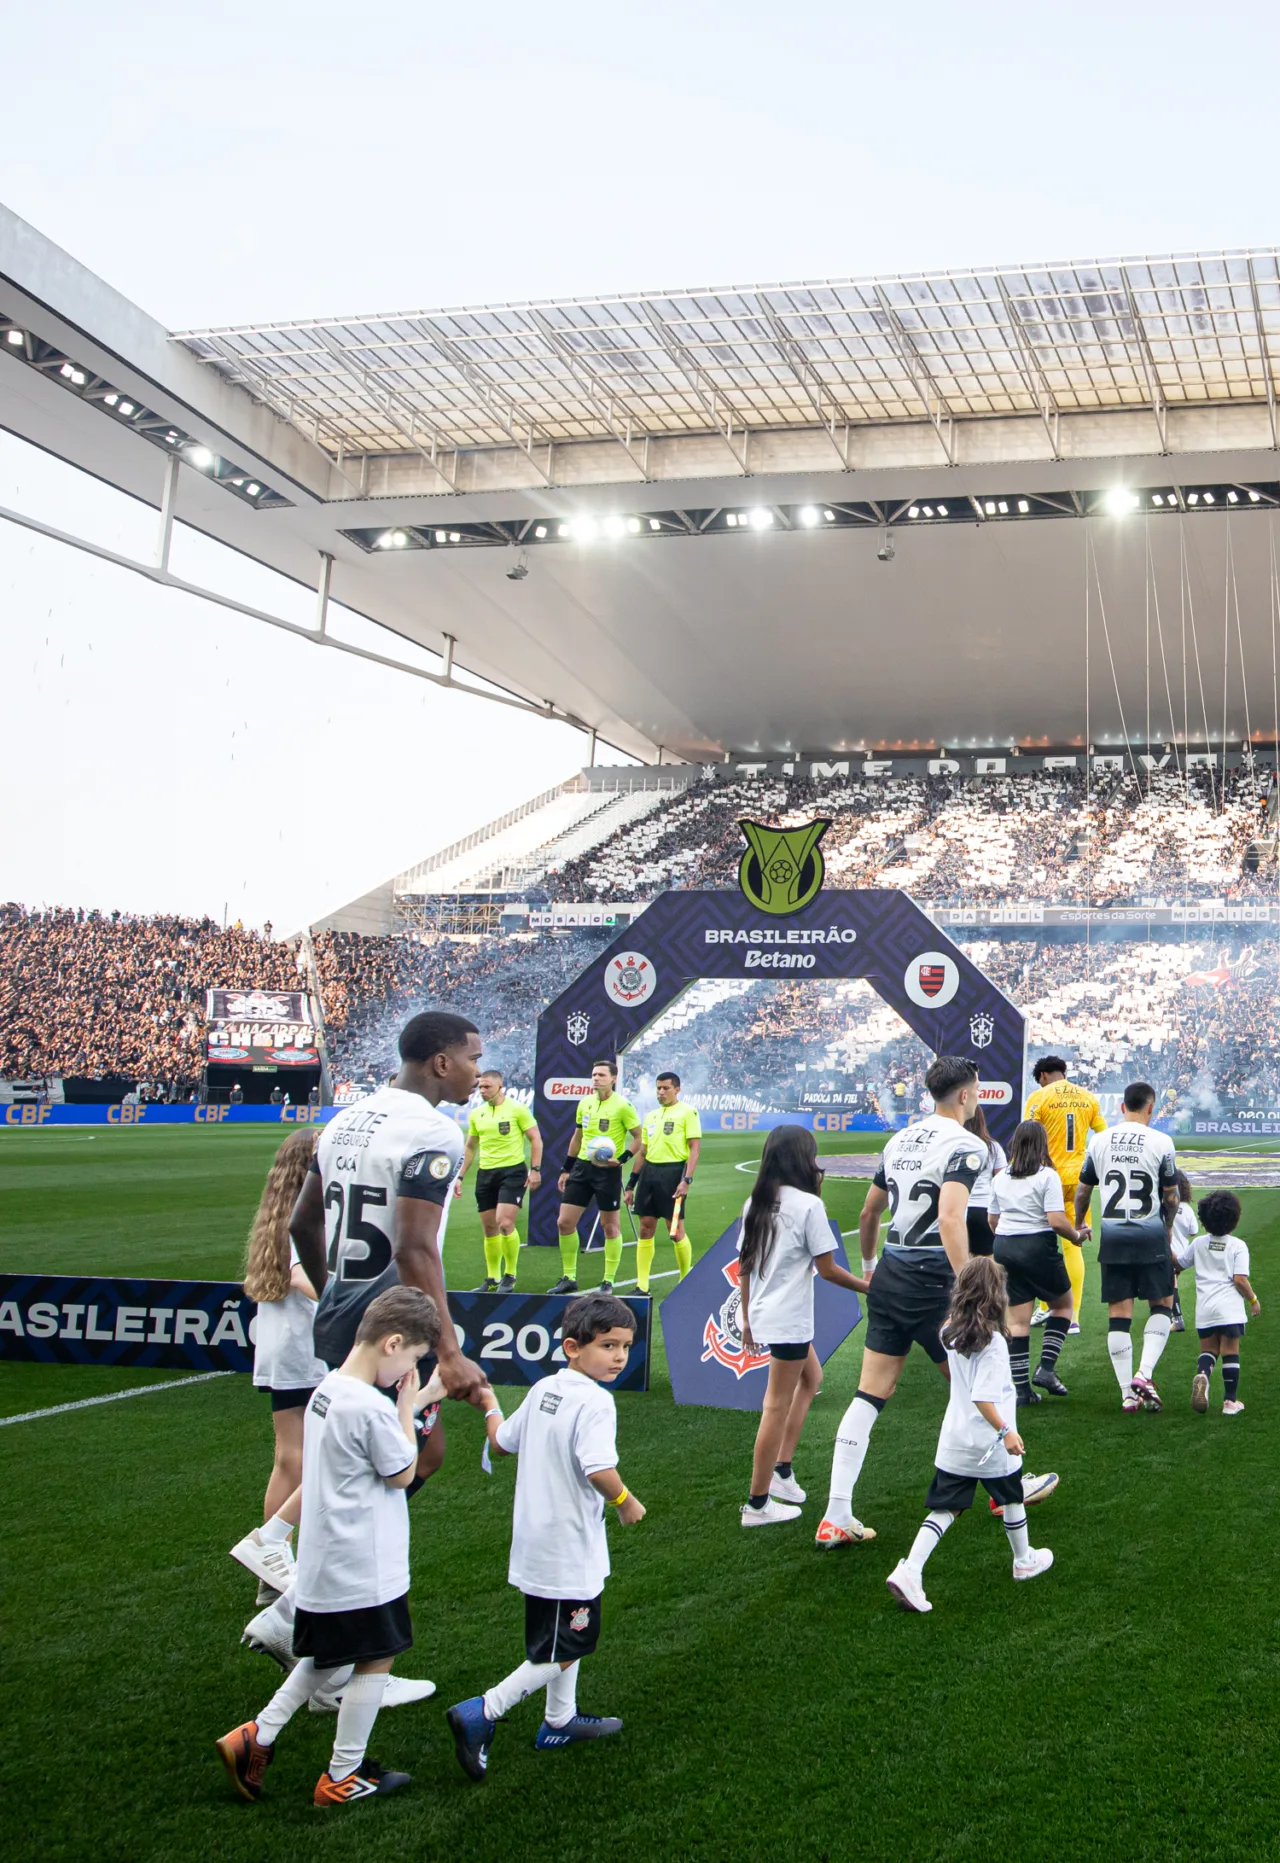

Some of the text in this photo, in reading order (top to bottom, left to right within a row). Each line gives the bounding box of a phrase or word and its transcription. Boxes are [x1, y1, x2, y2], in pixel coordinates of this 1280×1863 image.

[736, 761, 892, 779] TIME
[927, 758, 1006, 776] DO
[530, 915, 614, 925] MOSAICO
[992, 911, 1042, 921] FIEL
[1060, 910, 1157, 921] Esportes da Sorte
[705, 925, 857, 944] BRASILEIRÃO
[744, 950, 816, 968] Betano
[6, 1105, 51, 1124] CBF
[107, 1105, 147, 1123] CBF
[194, 1105, 231, 1122] CBF
[283, 1105, 321, 1123] CBF
[720, 1112, 760, 1130] CBF
[813, 1114, 854, 1132] CBF
[331, 1132, 372, 1148] SEGUROS
[1066, 1113, 1074, 1152] 1
[1110, 1133, 1145, 1146] EZZE
[1110, 1145, 1143, 1153] SEGUROS
[336, 1154, 357, 1172] CACÁ
[891, 1157, 922, 1171] HÉCTOR
[1111, 1155, 1139, 1164] FAGNER
[1102, 1169, 1153, 1219] 23
[886, 1178, 941, 1247] 22
[0, 1300, 257, 1347] ASILEIRÃ
[544, 1736, 570, 1744] FIT-7
